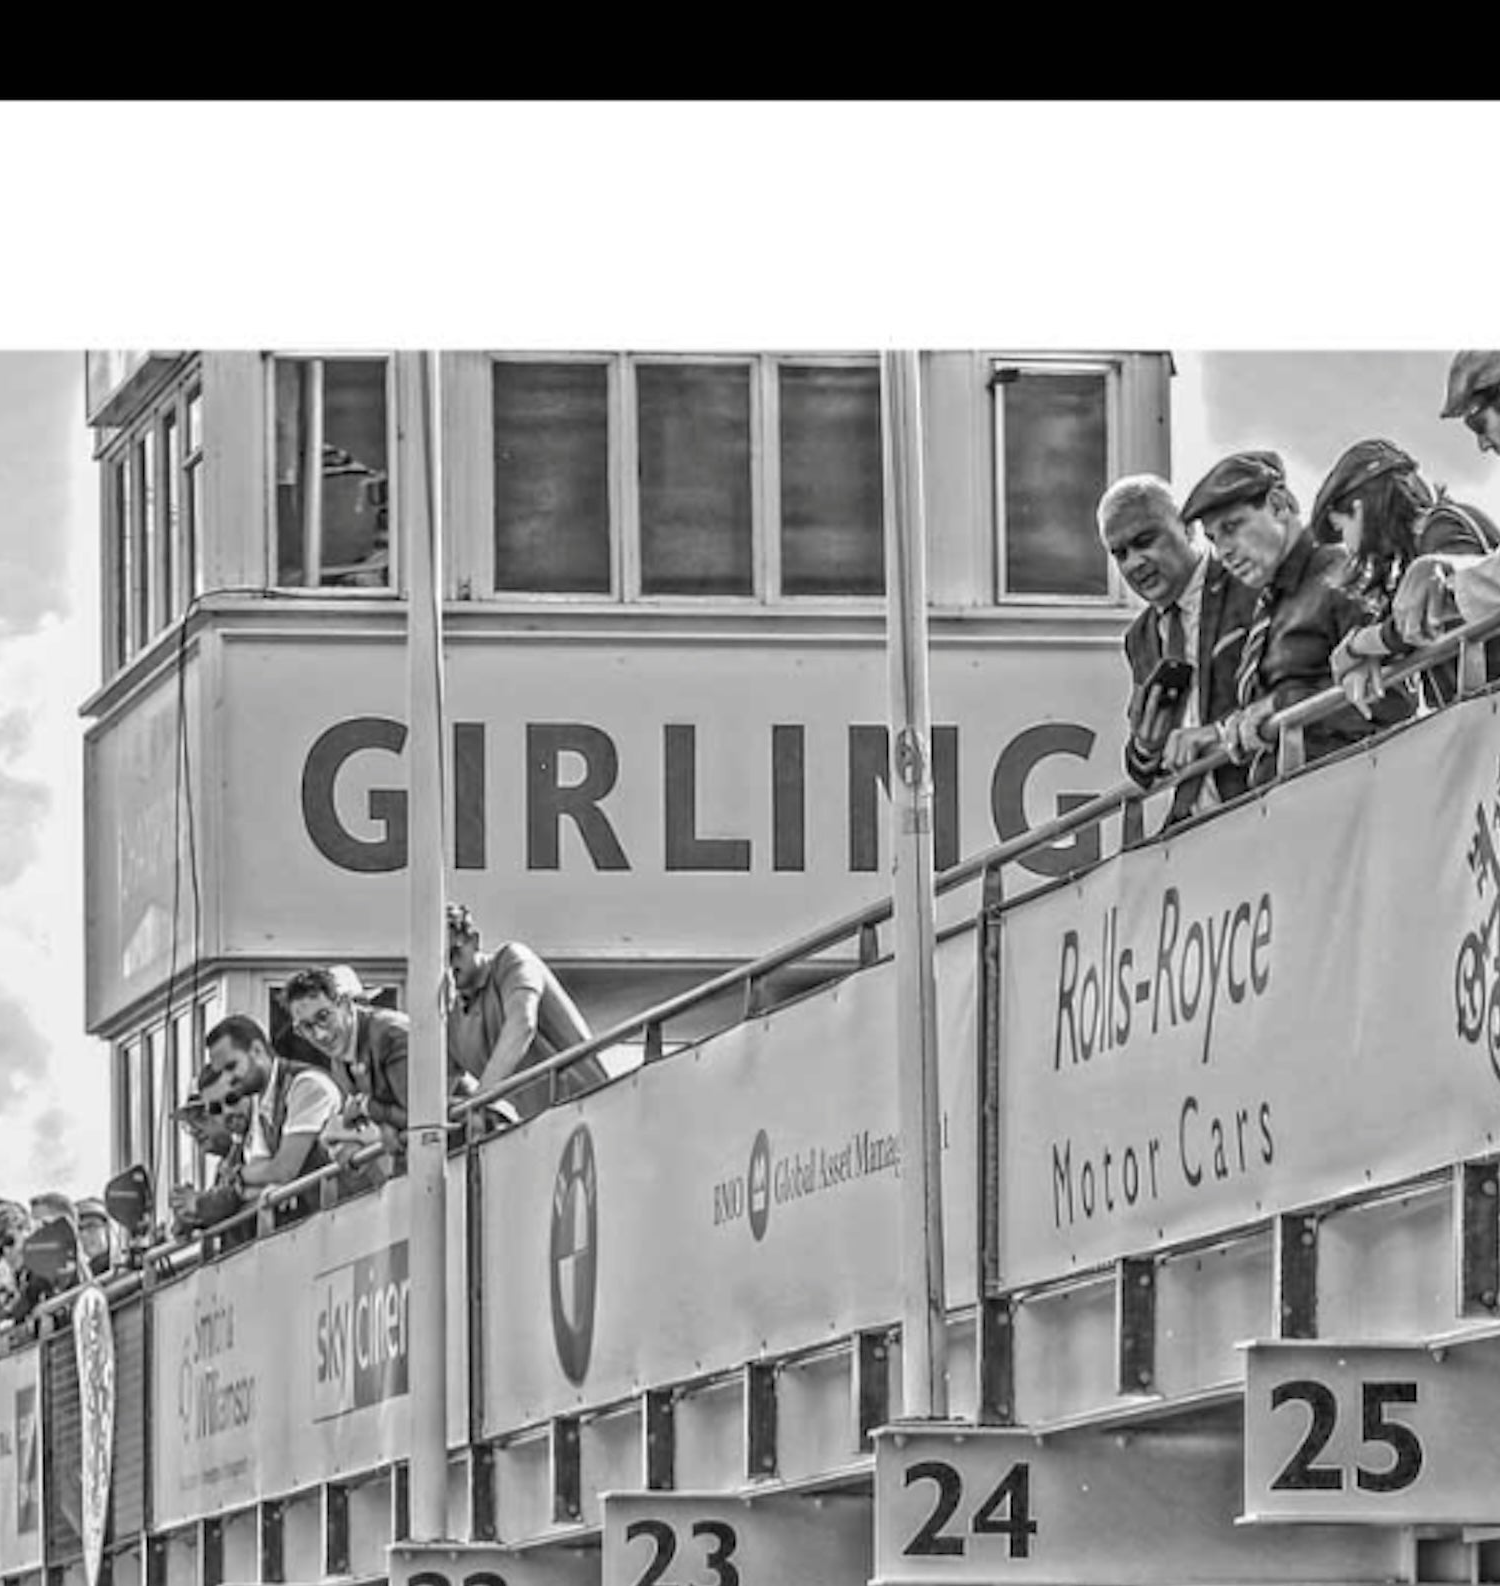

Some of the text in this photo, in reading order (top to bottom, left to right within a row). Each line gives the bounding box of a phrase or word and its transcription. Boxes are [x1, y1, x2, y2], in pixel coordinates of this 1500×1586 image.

[301, 716, 1101, 877] GIRLING
[1054, 888, 1273, 1071] Rolls-Royce
[774, 1147, 817, 1205] Global
[819, 1141, 852, 1191] Asset
[1053, 1095, 1275, 1228] Motor Cars
[317, 1284, 351, 1409] sky
[1270, 1380, 1424, 1493] 25
[902, 1461, 1038, 1558] 24
